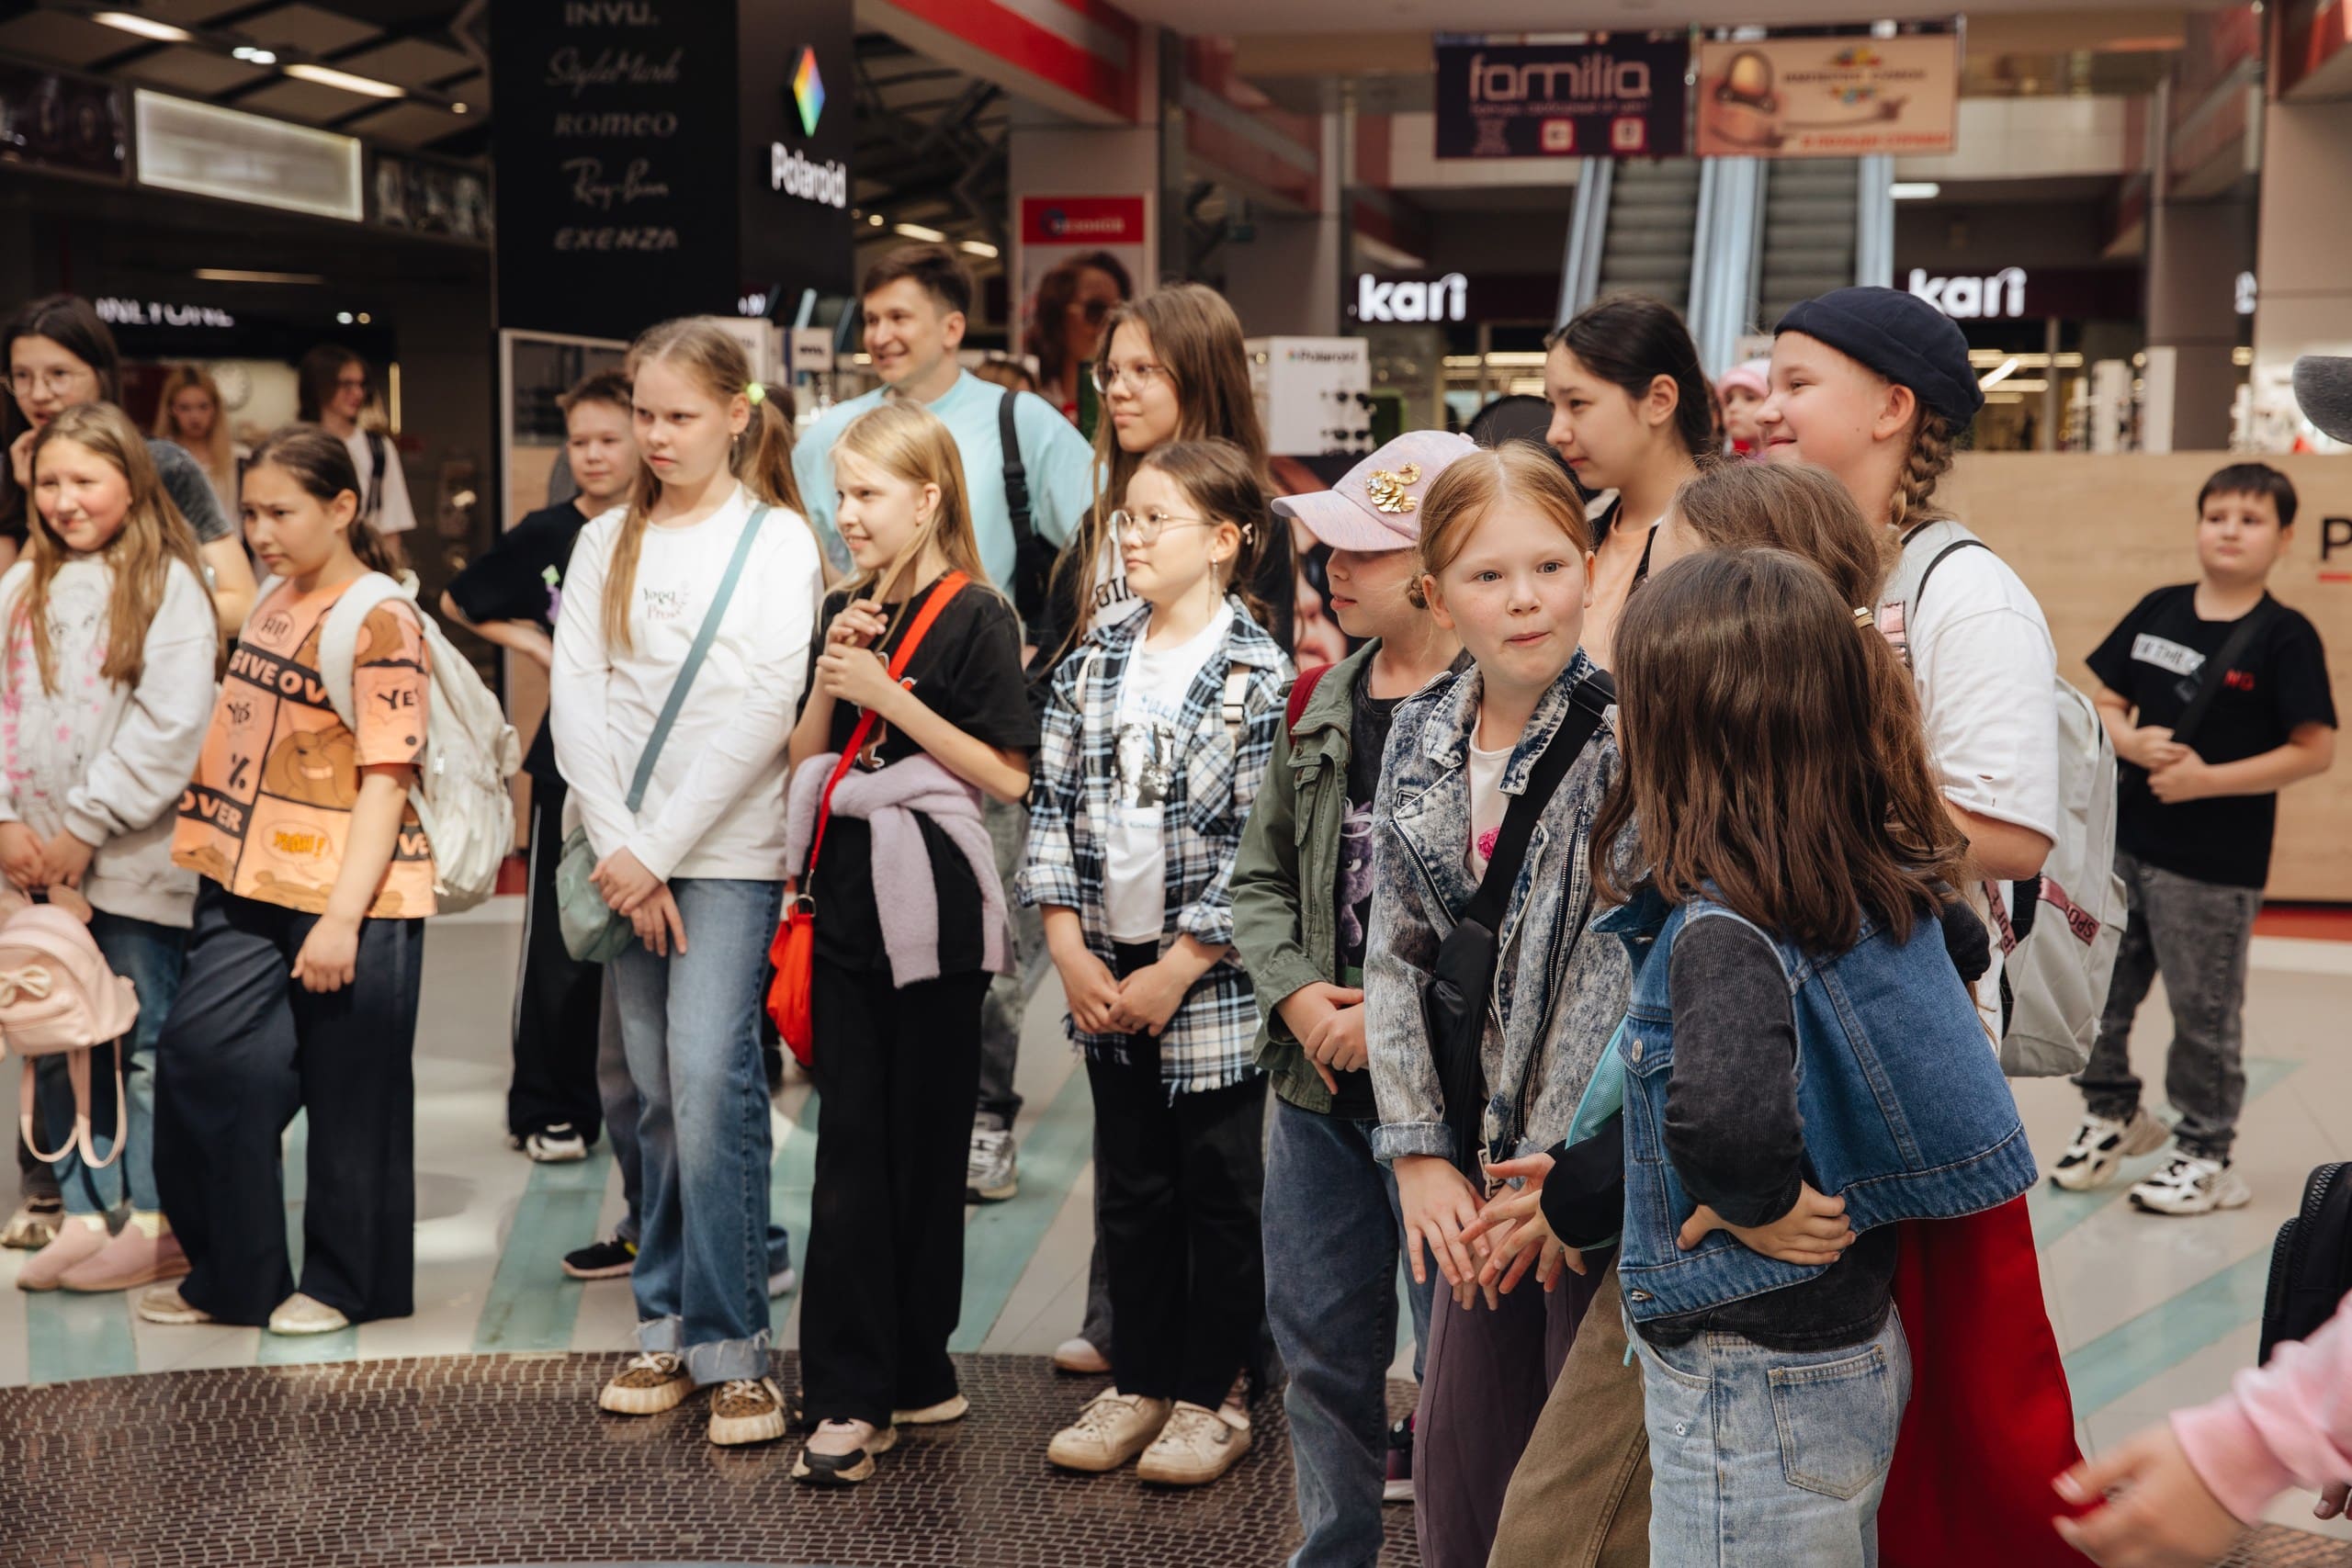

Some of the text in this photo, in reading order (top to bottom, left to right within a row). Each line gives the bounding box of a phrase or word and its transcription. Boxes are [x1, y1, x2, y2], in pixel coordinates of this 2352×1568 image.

[1468, 51, 1651, 102] familia
[771, 141, 846, 209] Polaroid
[1358, 272, 1468, 321] kari
[1908, 266, 2027, 318] kari
[2066, 904, 2096, 938] SPO
